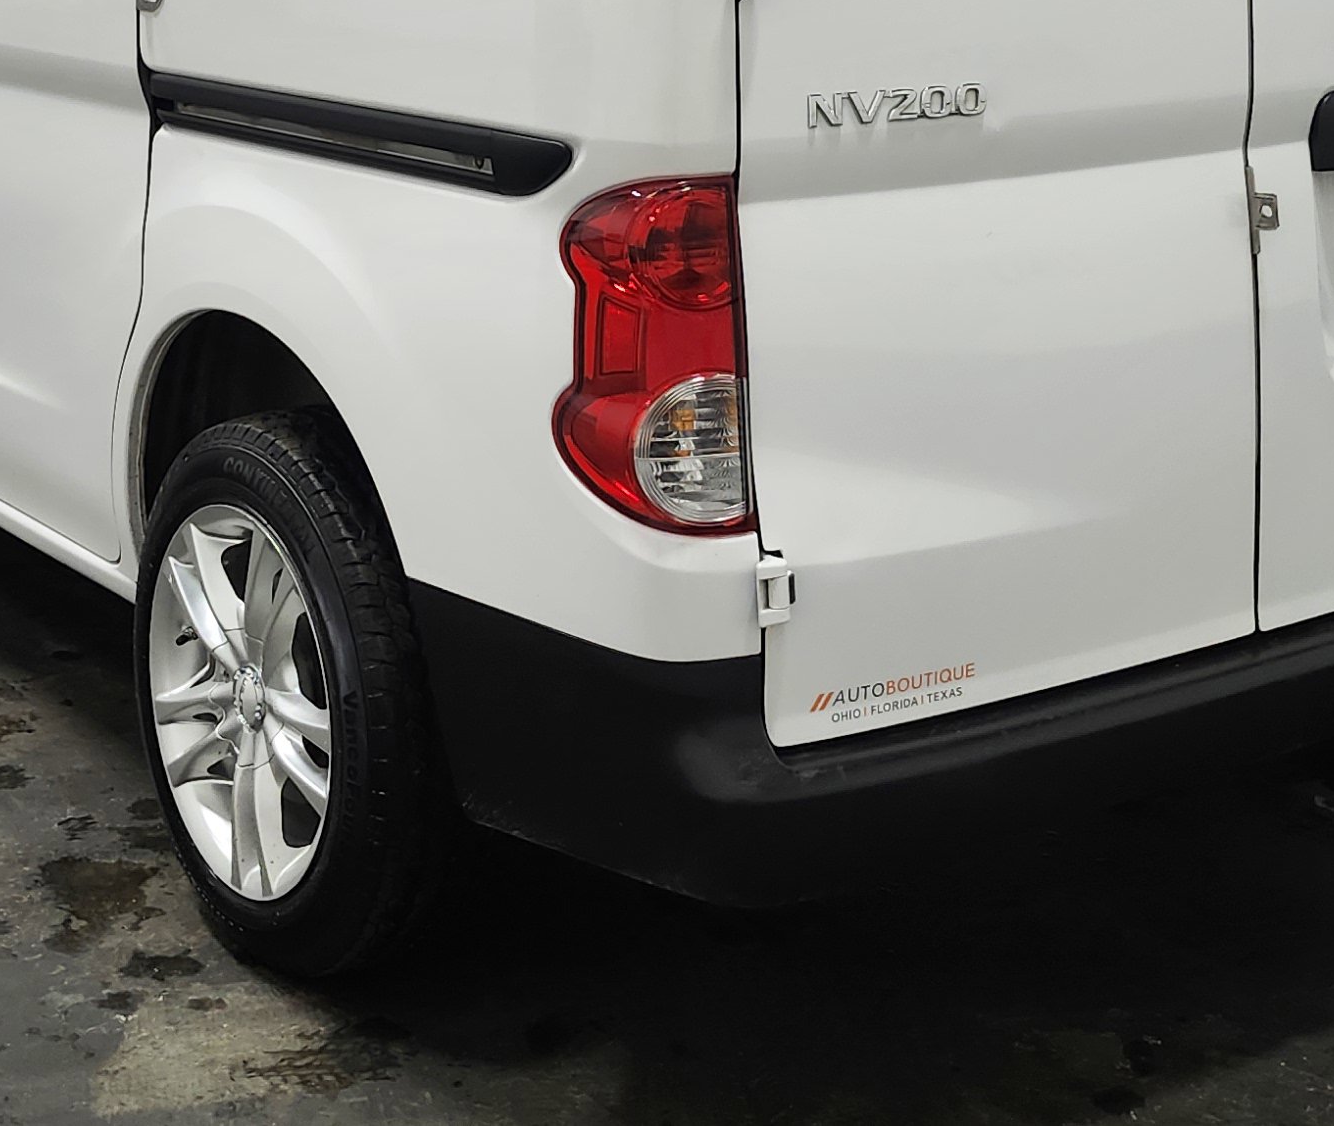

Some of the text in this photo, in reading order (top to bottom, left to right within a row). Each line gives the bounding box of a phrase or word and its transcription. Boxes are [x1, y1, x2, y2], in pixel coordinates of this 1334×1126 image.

[807, 82, 989, 130] NV200
[831, 662, 976, 707] AUTOBOUTIQUE
[831, 686, 964, 723] OHIO FLORIDA TEXAS
